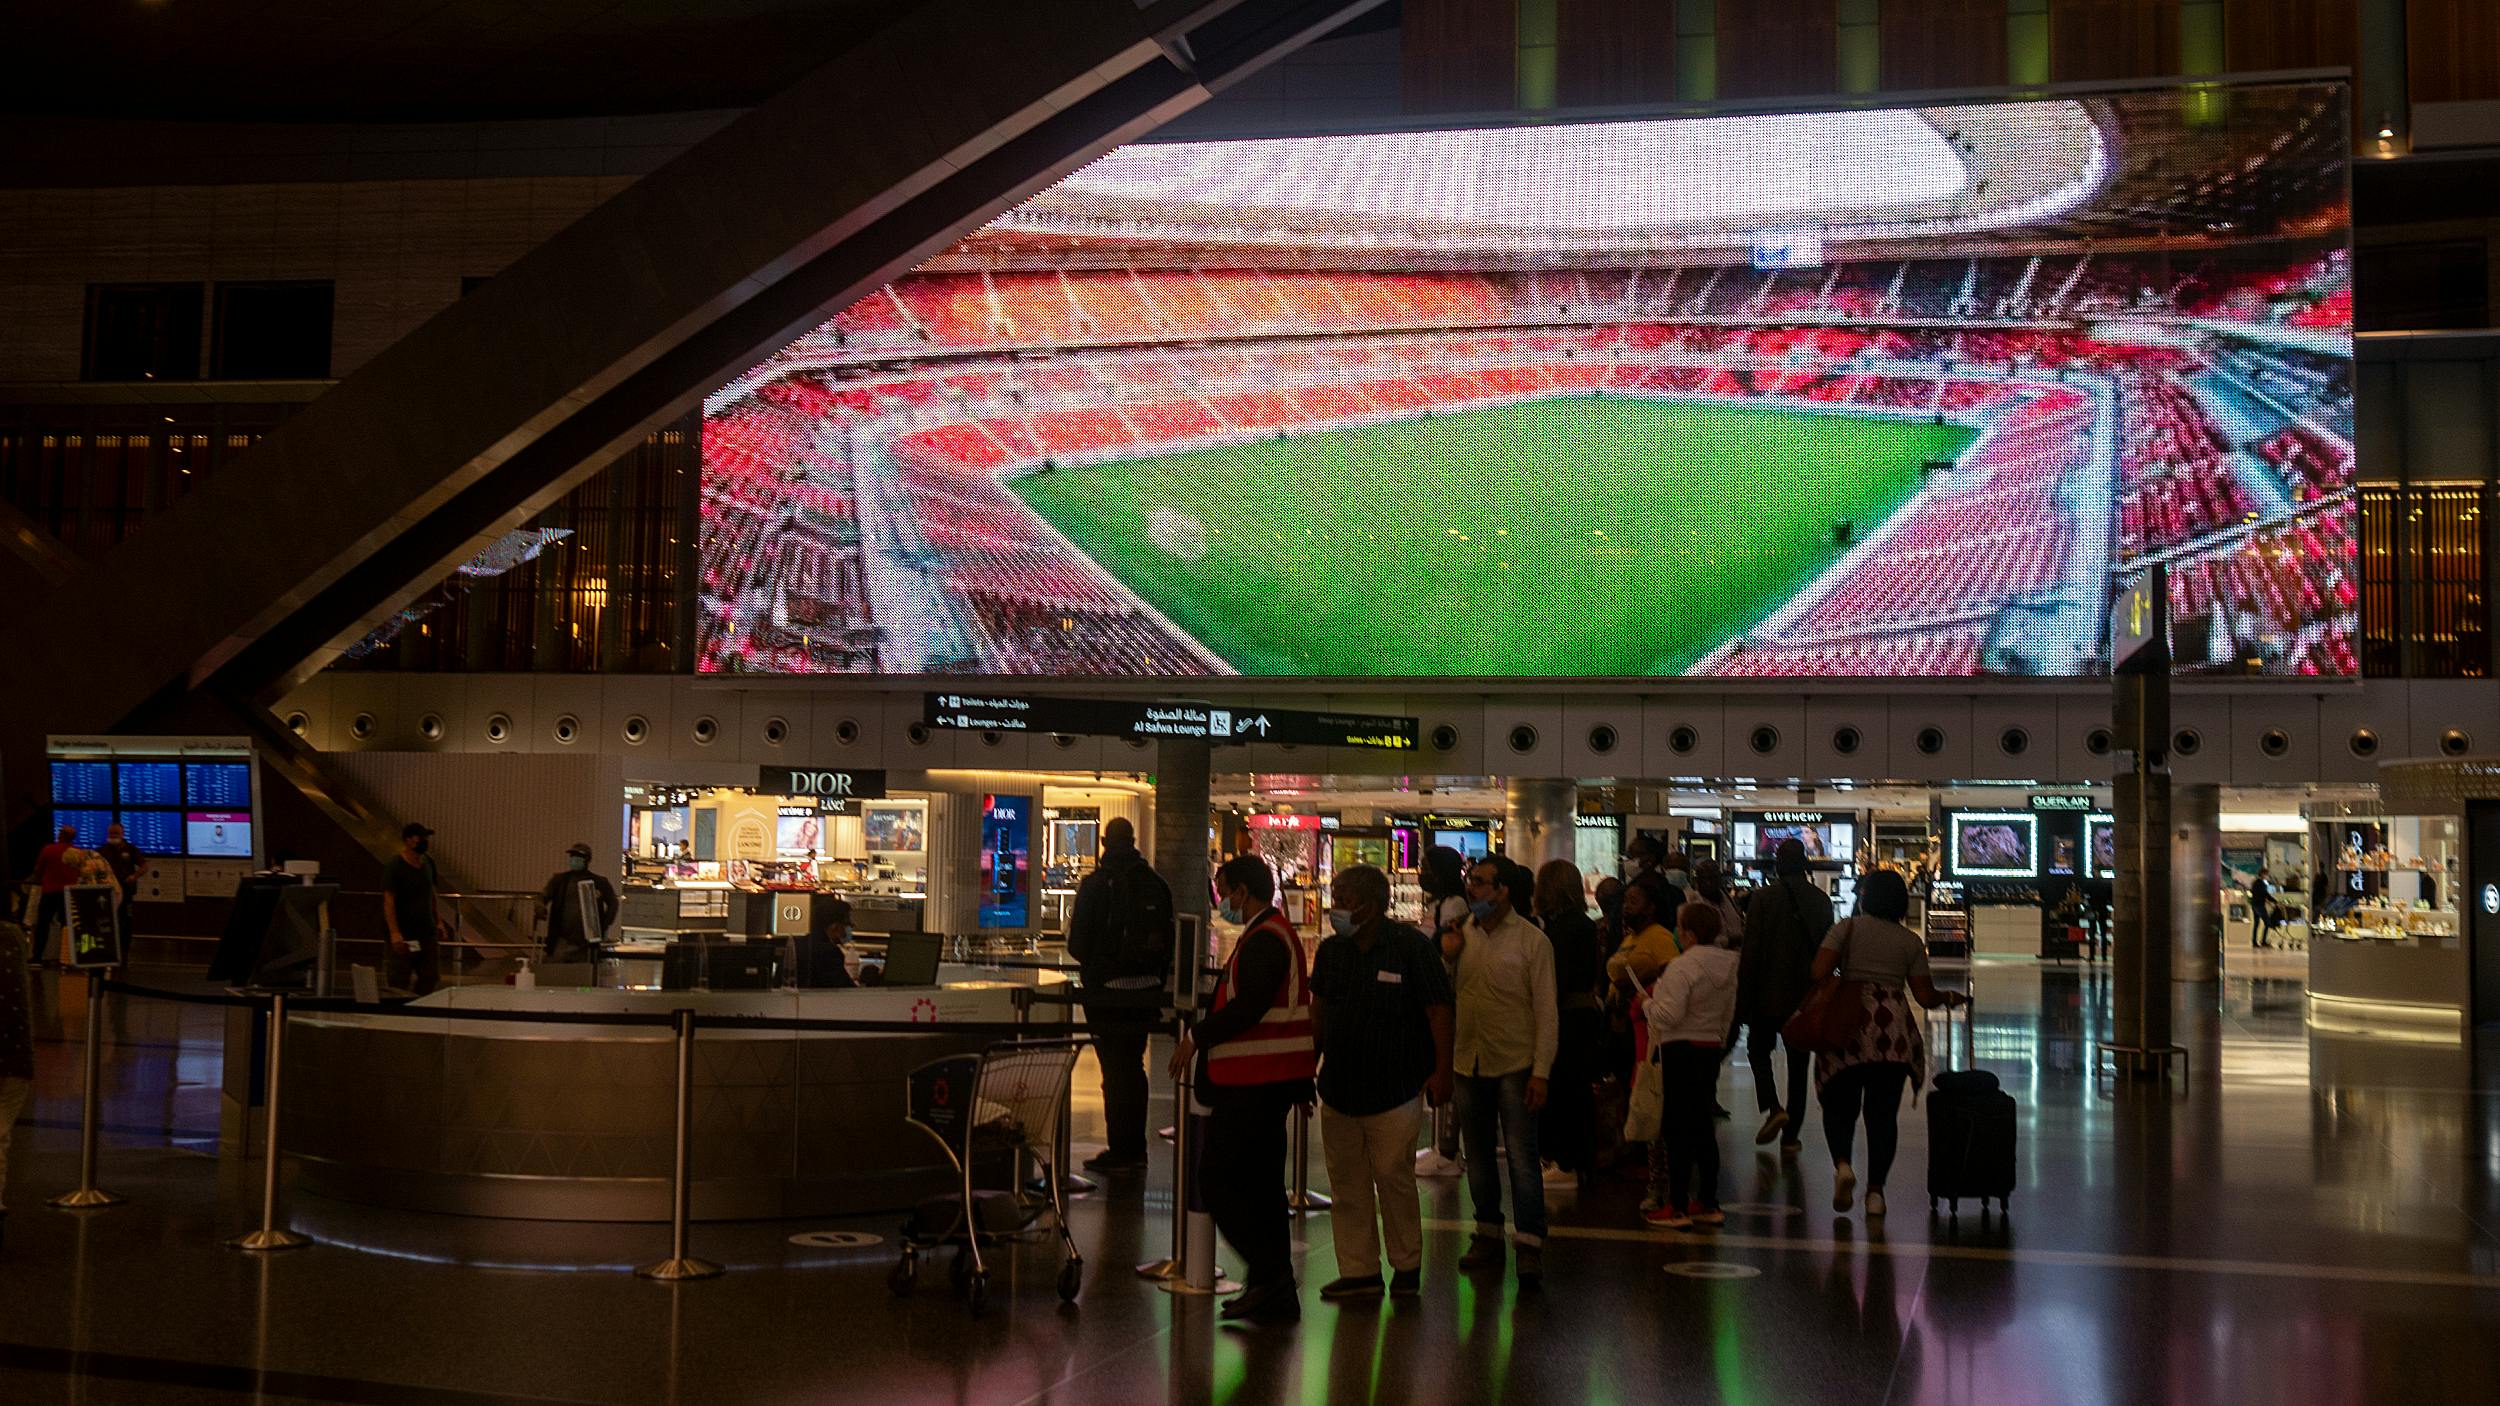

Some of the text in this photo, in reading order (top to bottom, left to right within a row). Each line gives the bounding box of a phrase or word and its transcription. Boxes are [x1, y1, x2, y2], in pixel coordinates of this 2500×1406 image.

[961, 697, 984, 707] Toilets
[1145, 706, 1207, 721] صالة الصفوة
[969, 716, 998, 729] Lounges
[1133, 720, 1207, 737] Al Safwa Lounge
[789, 770, 854, 797] DIOR
[2031, 794, 2091, 807] GUERLAIN
[992, 806, 1017, 821] DIOR
[1573, 813, 1621, 827] CHANEL
[1763, 810, 1823, 823] GIVENCHY
